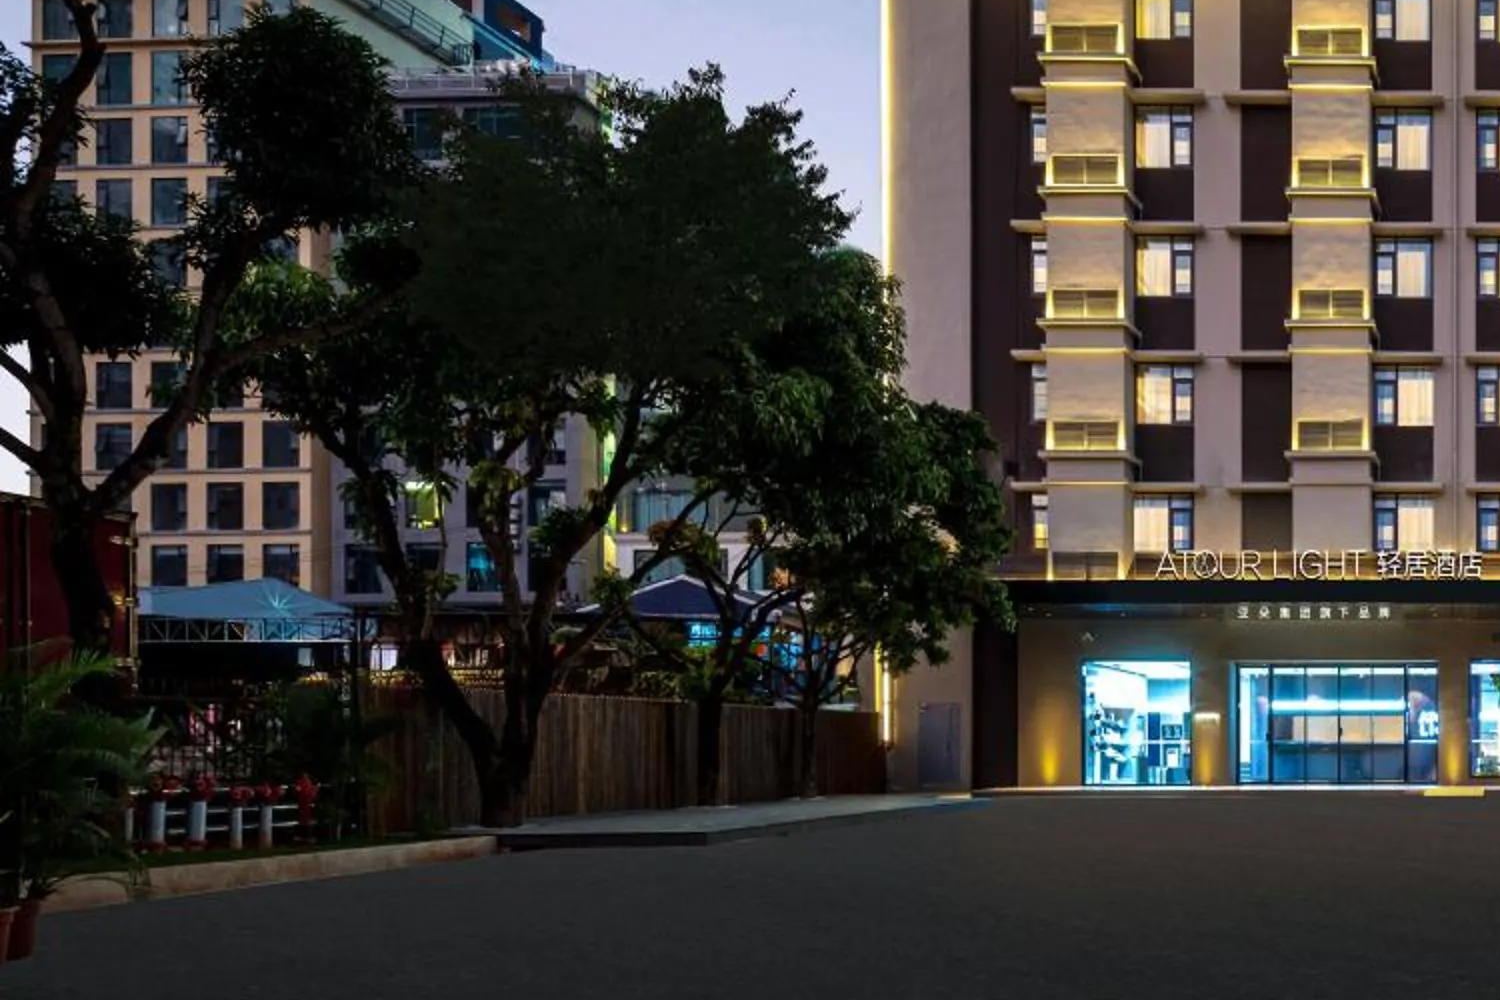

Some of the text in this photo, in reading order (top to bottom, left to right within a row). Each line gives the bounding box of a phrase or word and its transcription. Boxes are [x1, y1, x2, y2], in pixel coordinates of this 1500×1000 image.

[1155, 550, 1482, 580] ATOUR LIGHT 轻居酒店
